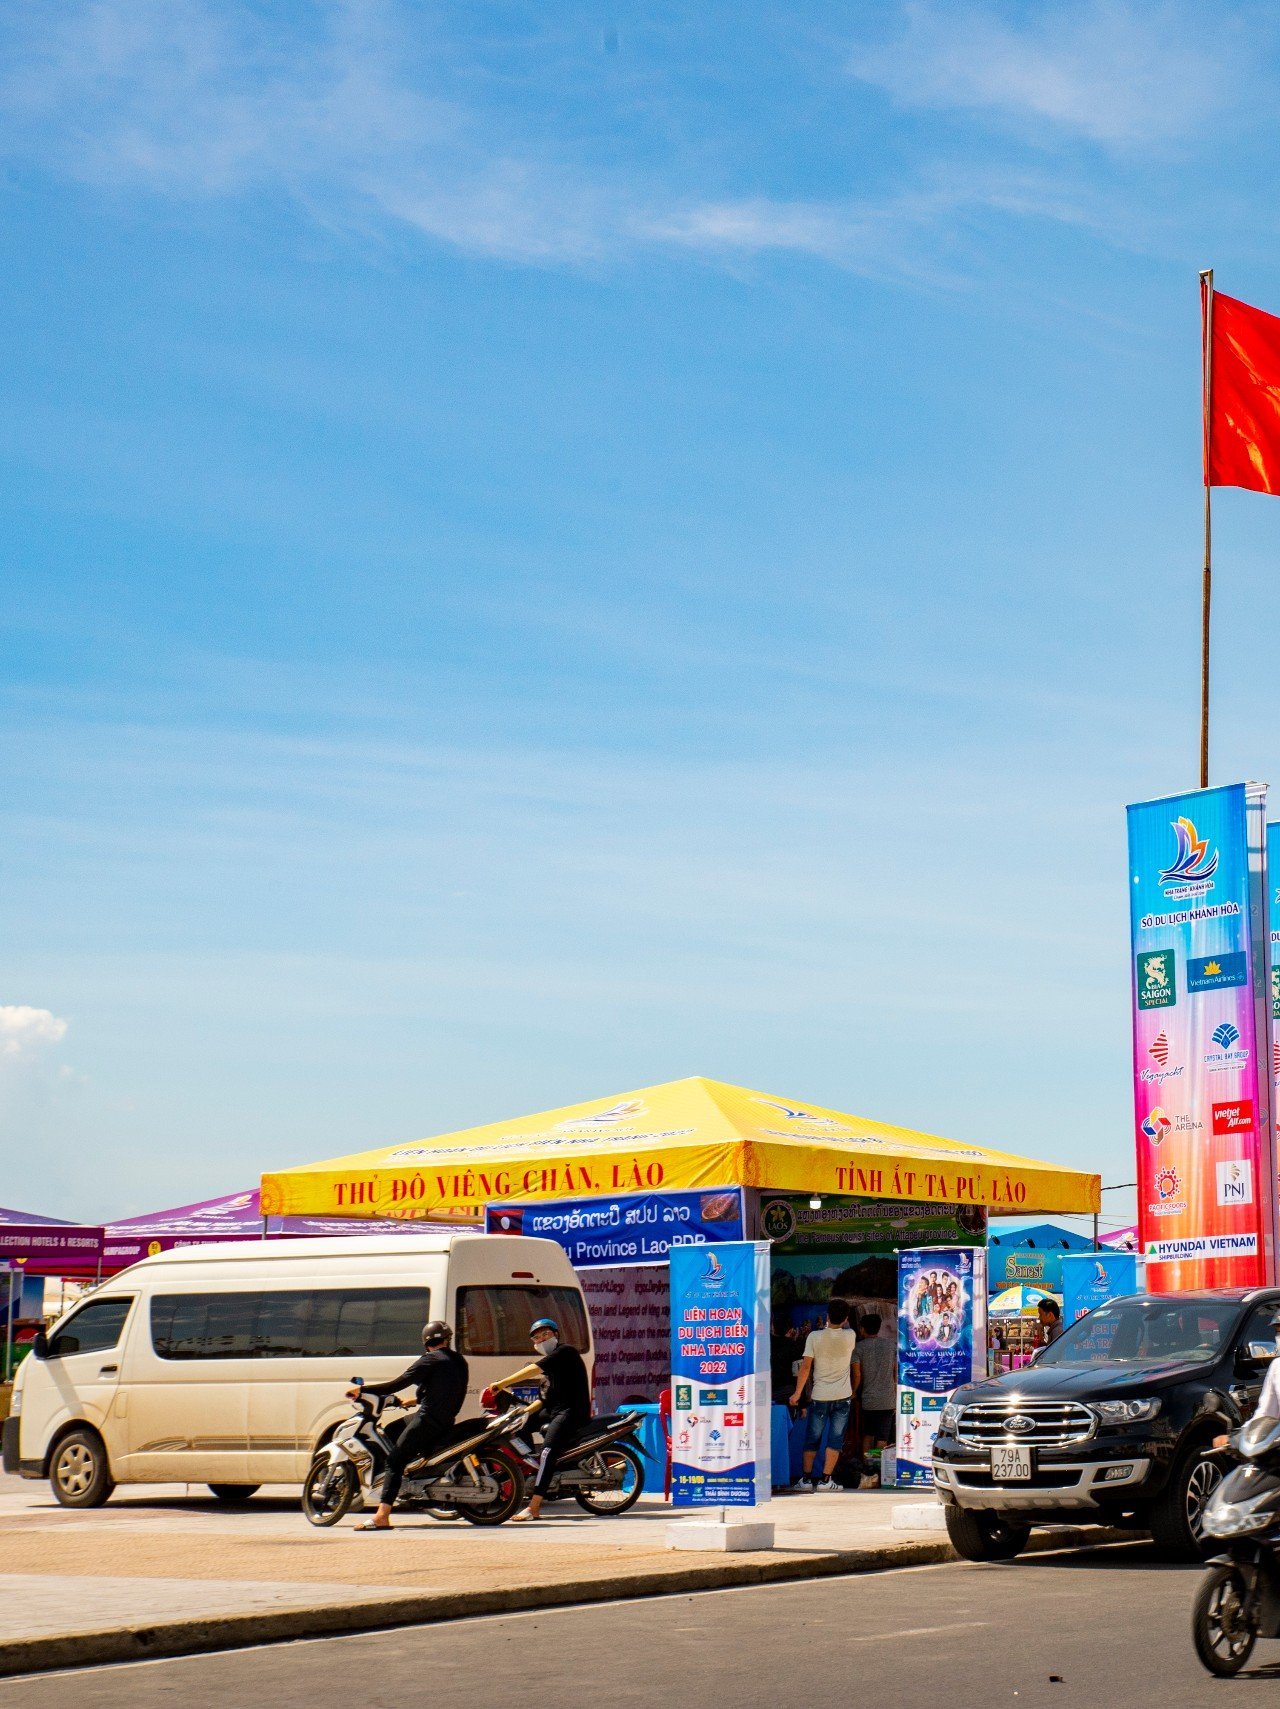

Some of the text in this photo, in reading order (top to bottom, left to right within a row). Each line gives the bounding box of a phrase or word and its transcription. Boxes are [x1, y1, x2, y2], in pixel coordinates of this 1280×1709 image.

[1142, 901, 1239, 927] SỞ DU LỊCH KHÁNH HÒA
[1141, 988, 1171, 1000] SAIGON
[1145, 998, 1169, 1006] SPECIAL
[1175, 1122, 1203, 1131] ARENA
[334, 1174, 382, 1206] THỦ
[392, 1172, 426, 1201] ĐÔ
[612, 1158, 664, 1188] LÀO
[836, 1160, 883, 1193] TỈNH
[992, 1173, 1027, 1204] LÀO
[1224, 1182, 1245, 1199] PNJ
[663, 1205, 691, 1223] ລາວ
[768, 1222, 788, 1231] LAOS
[811, 1231, 840, 1242] Famous
[867, 1230, 884, 1241] sites
[925, 1227, 958, 1242] province
[31, 1237, 59, 1247] HOTELS
[60, 1238, 66, 1247] &
[67, 1238, 99, 1249] RESORTS
[576, 1241, 637, 1259] Province
[641, 1238, 667, 1255] Lao
[1159, 1236, 1256, 1254] HYUNDAI VIETNAM
[1159, 1252, 1193, 1260] SHIPBUILDING
[1007, 1256, 1043, 1279] Sanest
[684, 1306, 742, 1320] LIÊN HOAN
[678, 1319, 748, 1341] DU LỊCH BIỂN
[682, 1343, 745, 1356] NHA TRANG
[700, 1361, 726, 1374] 2022
[1009, 1420, 1026, 1429] Ford
[1001, 1450, 1021, 1462] 79A
[994, 1463, 1029, 1478] 237.00
